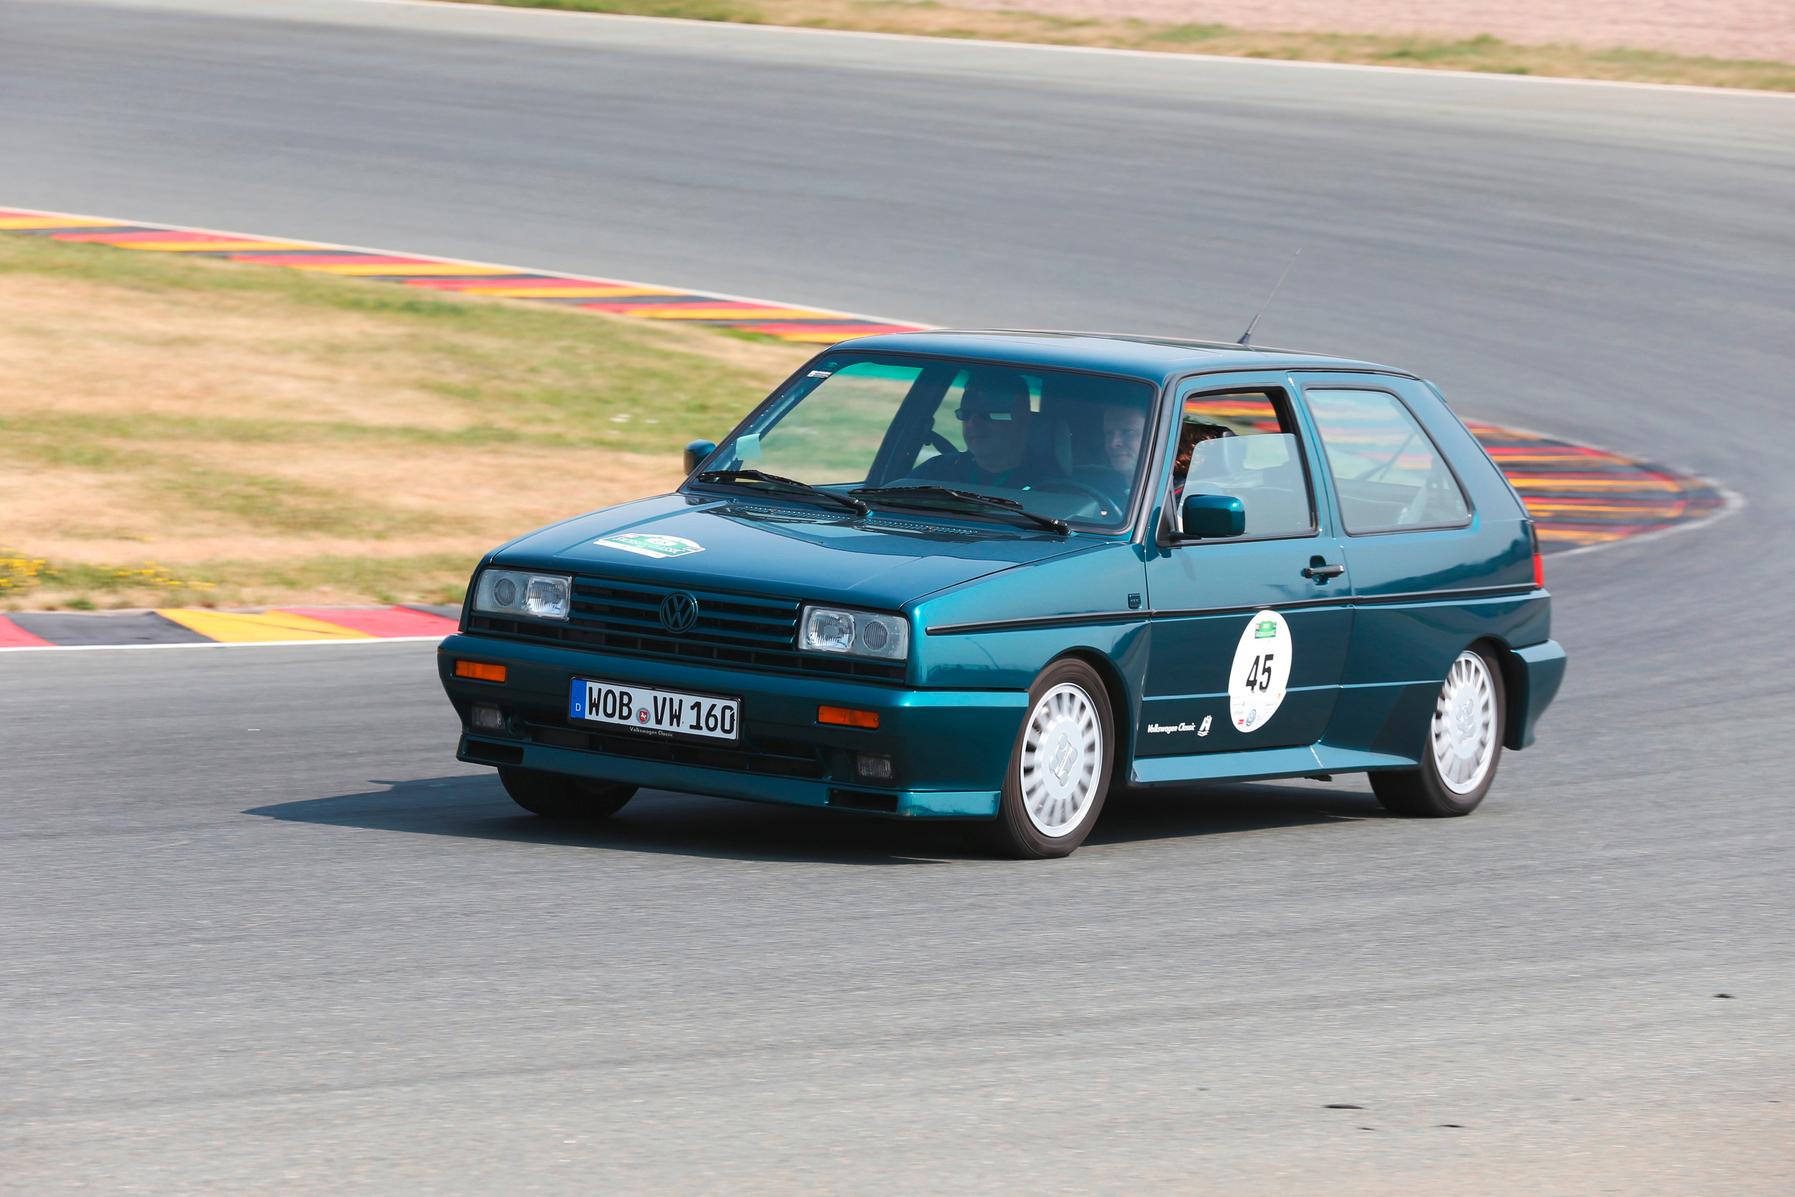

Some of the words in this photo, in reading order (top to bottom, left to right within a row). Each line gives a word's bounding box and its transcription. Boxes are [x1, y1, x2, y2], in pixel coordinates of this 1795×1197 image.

[1246, 654, 1274, 692] 45
[575, 702, 582, 712] D
[588, 686, 633, 720] WOB
[653, 695, 683, 728] VW
[689, 701, 736, 735] 160
